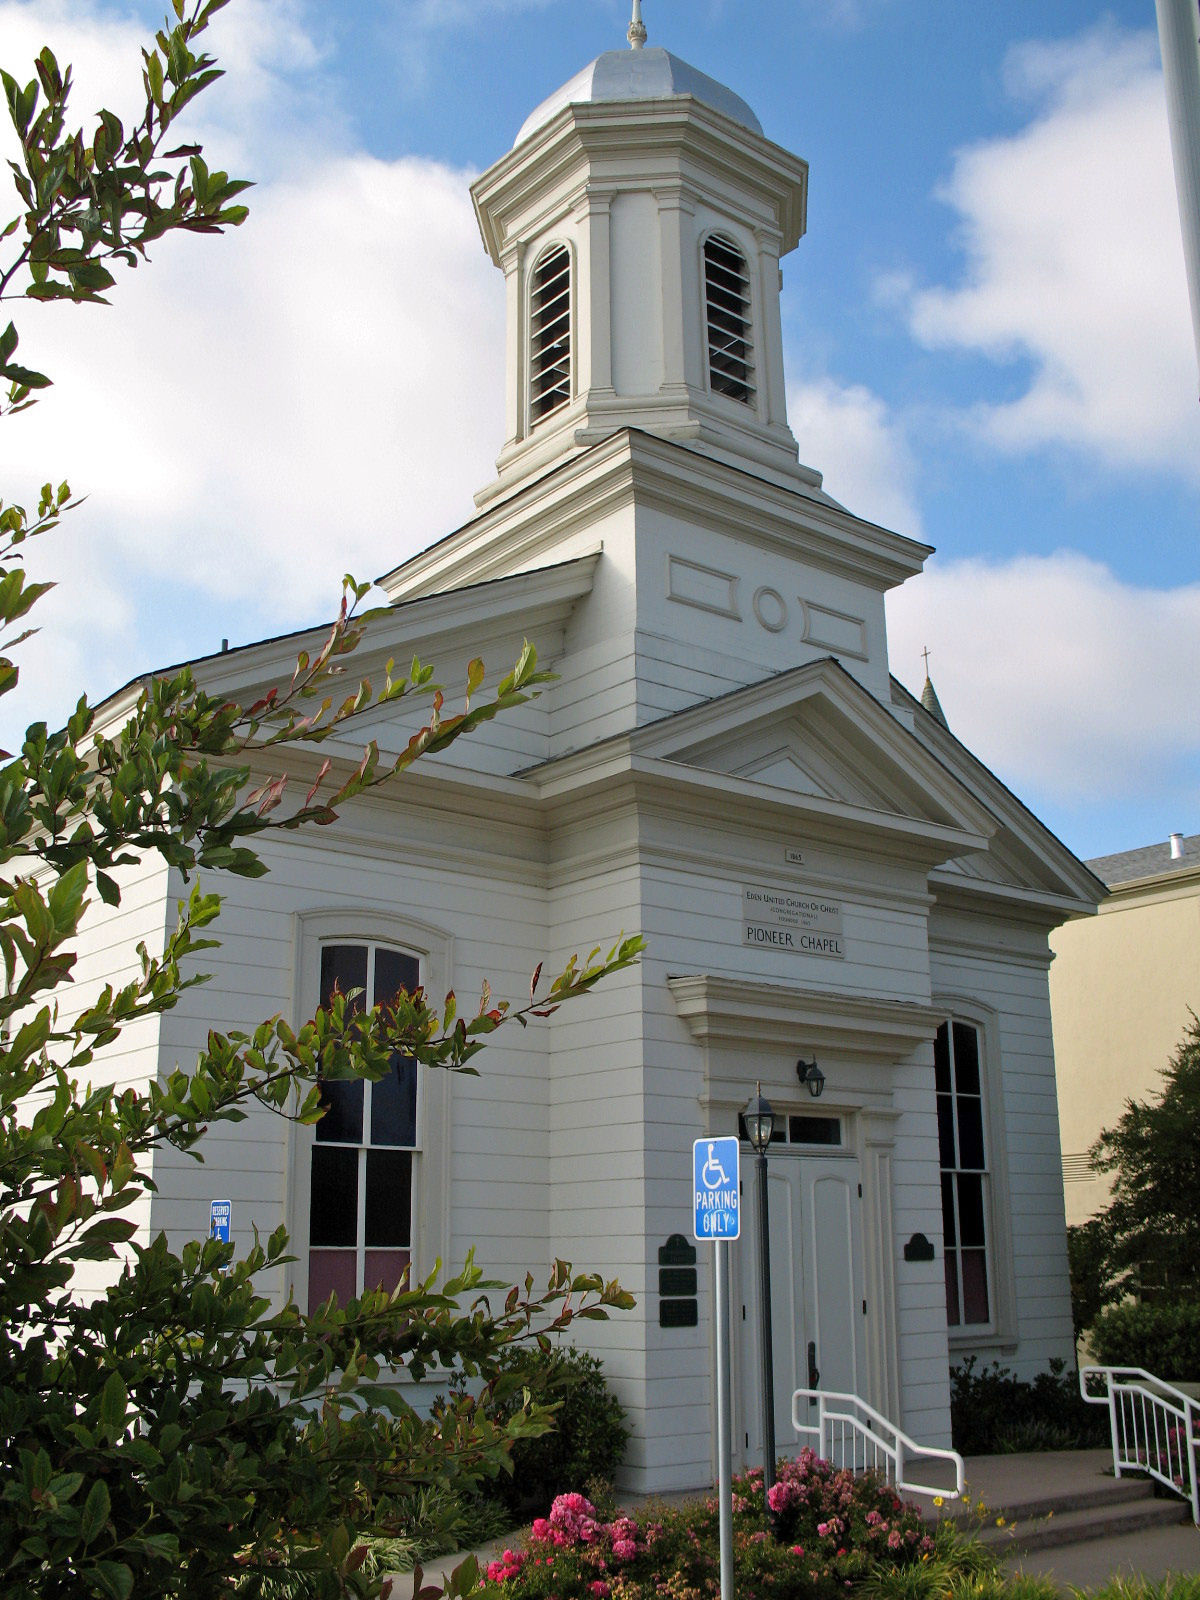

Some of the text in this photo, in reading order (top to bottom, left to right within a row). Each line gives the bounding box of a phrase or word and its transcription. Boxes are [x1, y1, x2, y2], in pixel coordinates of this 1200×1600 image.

[746, 926, 842, 953] PIONEER CHAPEL
[696, 1189, 737, 1210] PARKING
[703, 1211, 730, 1233] ONLY
